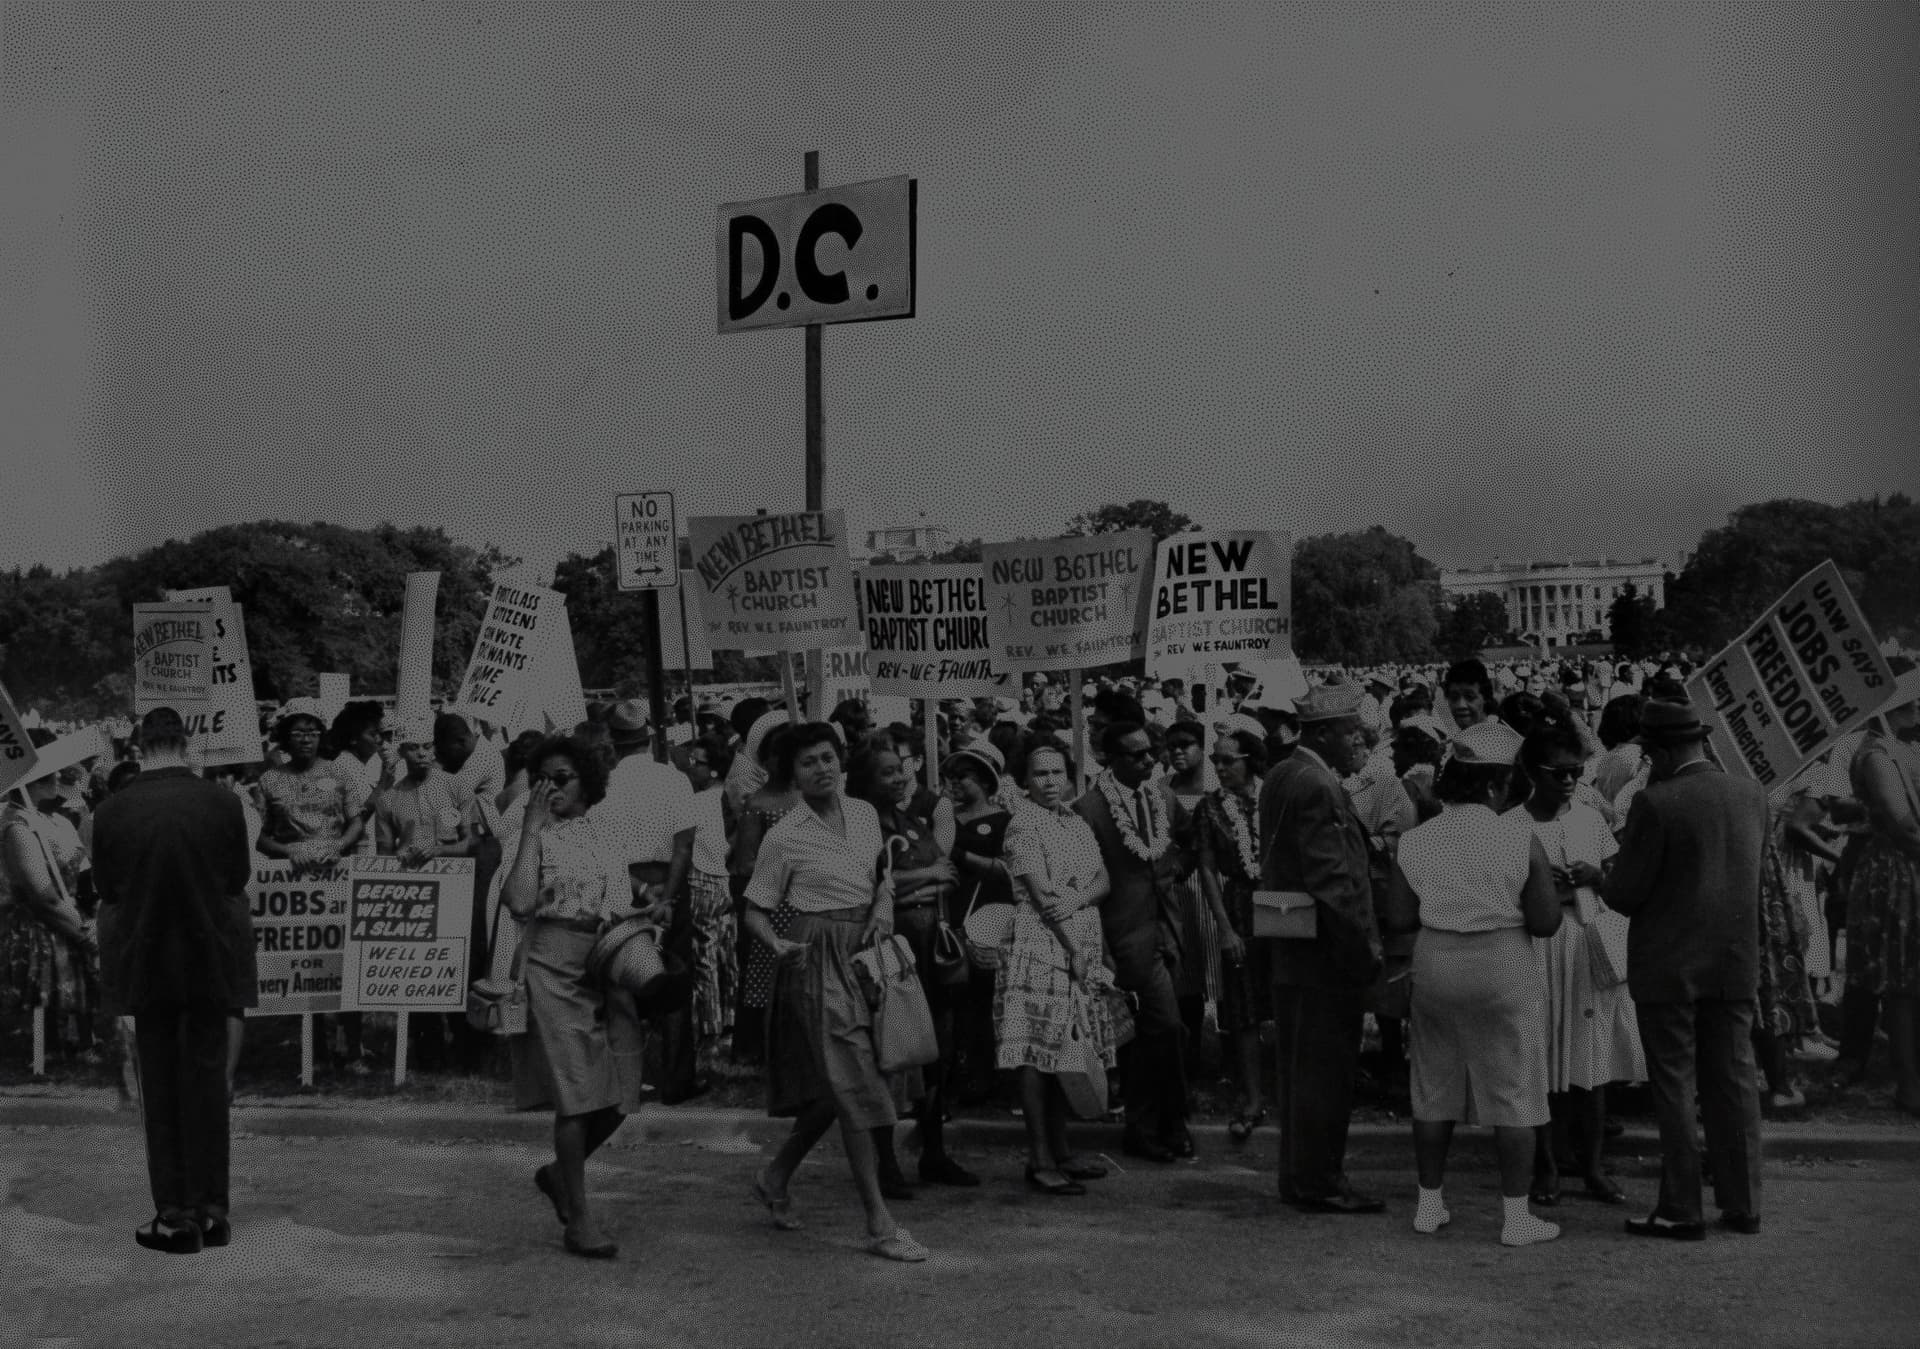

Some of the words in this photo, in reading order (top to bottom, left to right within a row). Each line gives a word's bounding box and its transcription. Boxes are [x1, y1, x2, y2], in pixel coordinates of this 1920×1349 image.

[728, 202, 879, 321] D.C.
[631, 499, 658, 518] NO
[621, 519, 670, 534] PARKING
[624, 536, 637, 549] AT
[645, 535, 668, 548] ANY
[696, 531, 742, 591] NEW
[737, 513, 836, 559] BETHEL
[634, 550, 660, 564] TIME
[991, 556, 1044, 585] NEW
[1053, 547, 1139, 583] BETHEL
[1166, 540, 1254, 579] NEW
[744, 566, 830, 593] BAPTIST
[741, 592, 817, 612] CHURCH
[866, 578, 904, 613] NEW
[1031, 582, 1109, 607] BAPTIST
[1156, 577, 1278, 620] BETHEL
[778, 617, 848, 634] FAUNTROY
[1030, 604, 1107, 627] CHURCH
[152, 620, 205, 641] BETHEL
[495, 628, 524, 650] VOTE
[868, 617, 929, 652] BAPTIST
[933, 616, 990, 652] CHUR
[1152, 619, 1212, 645] BAPTIST
[1218, 617, 1289, 636] CHURCH
[1812, 579, 1851, 633] UAW
[1841, 637, 1884, 690] SAYS
[1075, 631, 1142, 654] FAUNTROY
[1214, 637, 1271, 652] FAUNTROY
[153, 650, 201, 668] BAPTIST
[1778, 600, 1841, 685] JOBS
[1820, 684, 1859, 725] and
[150, 665, 192, 680] CHURCH
[1745, 623, 1829, 755] FREEDOM
[1746, 689, 1772, 729] FOR
[183, 710, 226, 738] ULE
[1706, 659, 1736, 712] Every
[1725, 703, 1777, 787] American
[256, 869, 302, 883] UAW
[250, 890, 326, 917] JOBS
[356, 884, 434, 901] BEFORE
[356, 901, 405, 919] WE'LL
[408, 903, 435, 919] BE
[254, 924, 346, 953] FREEDO
[353, 920, 368, 936] A
[290, 959, 324, 970] FOR
[424, 947, 450, 962] BE
[365, 965, 432, 979] BURIED
[436, 966, 457, 980] IN
[259, 977, 289, 998] very
[292, 972, 343, 995] Americ
[365, 983, 399, 997] OUR
[404, 983, 457, 998] GRAVE
